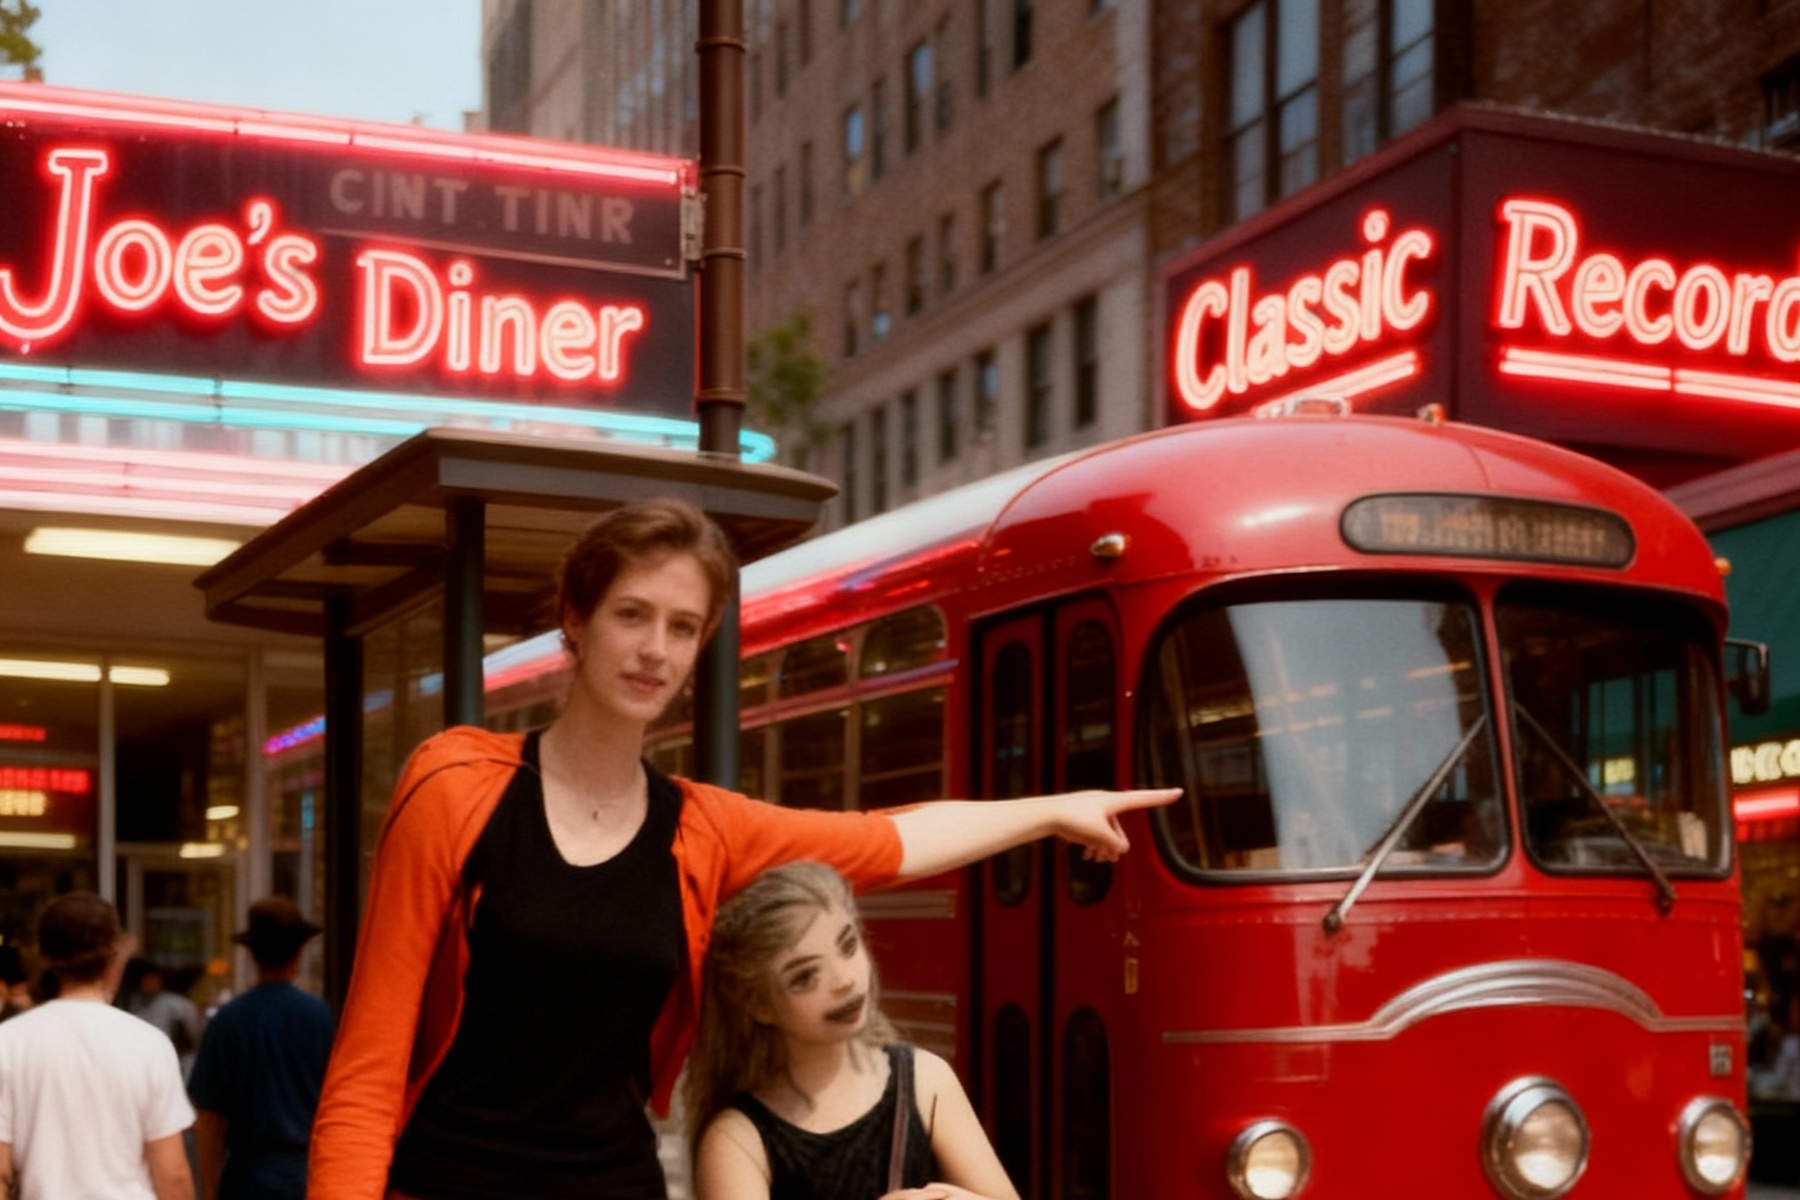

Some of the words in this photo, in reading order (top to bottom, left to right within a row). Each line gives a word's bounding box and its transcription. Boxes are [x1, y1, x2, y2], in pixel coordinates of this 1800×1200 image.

[0, 148, 318, 340] Joe's
[356, 250, 643, 380] Diner
[1176, 209, 1432, 410] Classic
